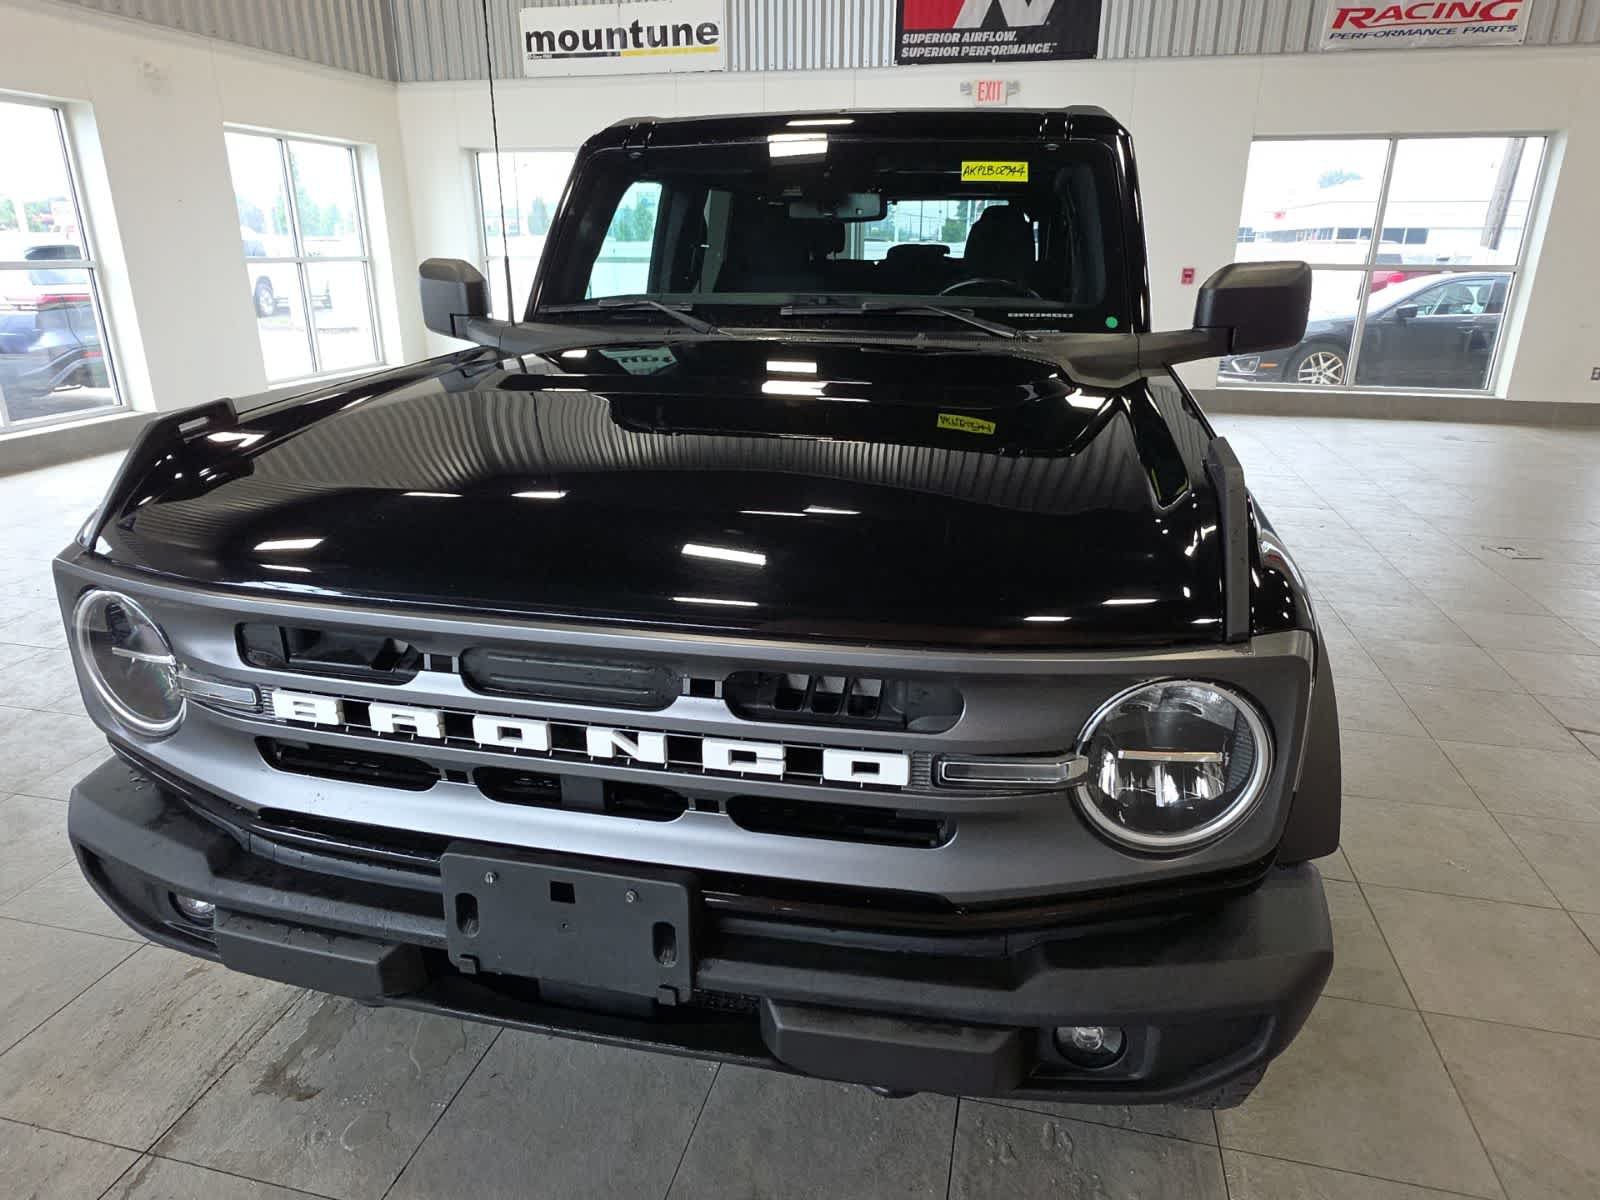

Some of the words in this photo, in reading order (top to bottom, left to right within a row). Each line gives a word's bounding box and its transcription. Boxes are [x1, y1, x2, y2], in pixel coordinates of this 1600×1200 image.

[1331, 0, 1523, 29] RACING
[525, 19, 720, 52] mountune
[902, 31, 960, 44] SUPERIOR
[961, 30, 1018, 43] AIRFLOW.
[1328, 27, 1457, 40] PERFORMANCE
[1462, 24, 1518, 34] PARTS
[901, 45, 959, 58] SUPERIOR
[977, 80, 1002, 102] EXIT
[271, 687, 910, 787] BRONCO
